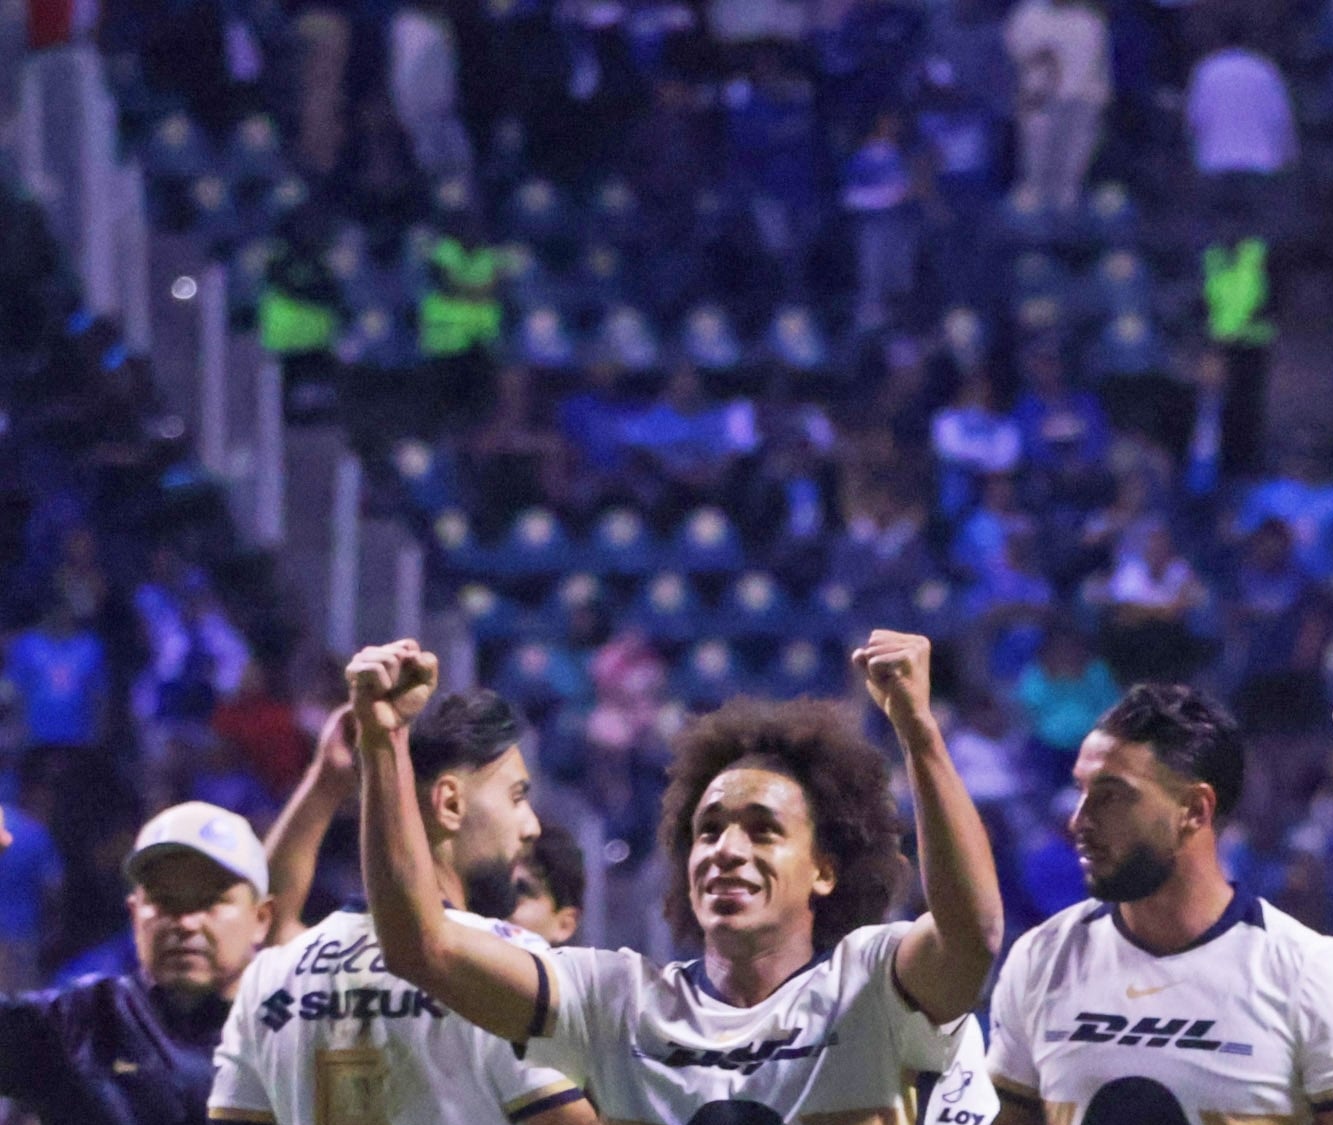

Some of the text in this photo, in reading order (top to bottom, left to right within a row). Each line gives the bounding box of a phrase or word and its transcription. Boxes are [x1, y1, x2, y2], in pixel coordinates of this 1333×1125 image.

[298, 989, 446, 1021] SUZUK
[1066, 1012, 1223, 1050] DHL
[936, 1107, 985, 1125] LOY
